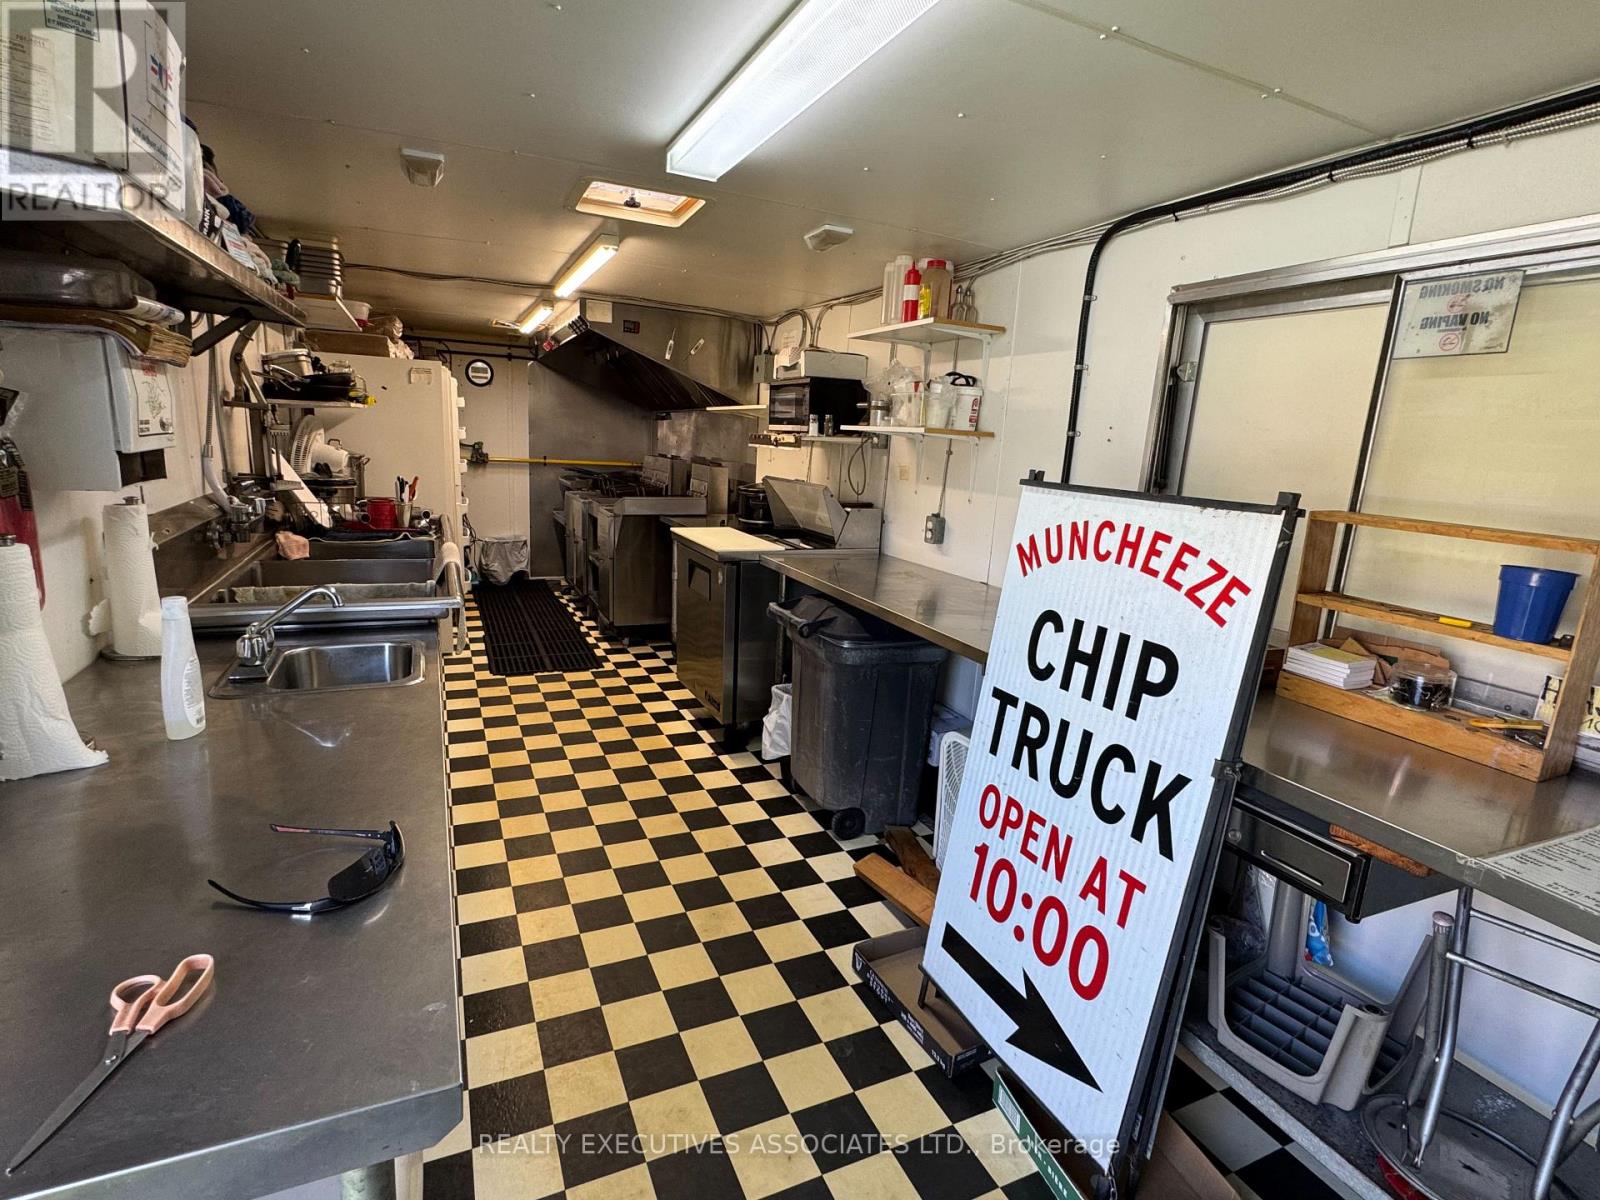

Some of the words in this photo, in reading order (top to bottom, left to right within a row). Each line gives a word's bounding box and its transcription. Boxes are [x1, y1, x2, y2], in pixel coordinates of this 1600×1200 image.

[1016, 520, 1252, 628] MUNCHEEZE
[1027, 609, 1179, 721] CHIP
[988, 686, 1192, 863] TRUCK
[969, 842, 1110, 1001] 10:00
[979, 784, 1073, 883] OPEN
[1079, 856, 1146, 929] AT
